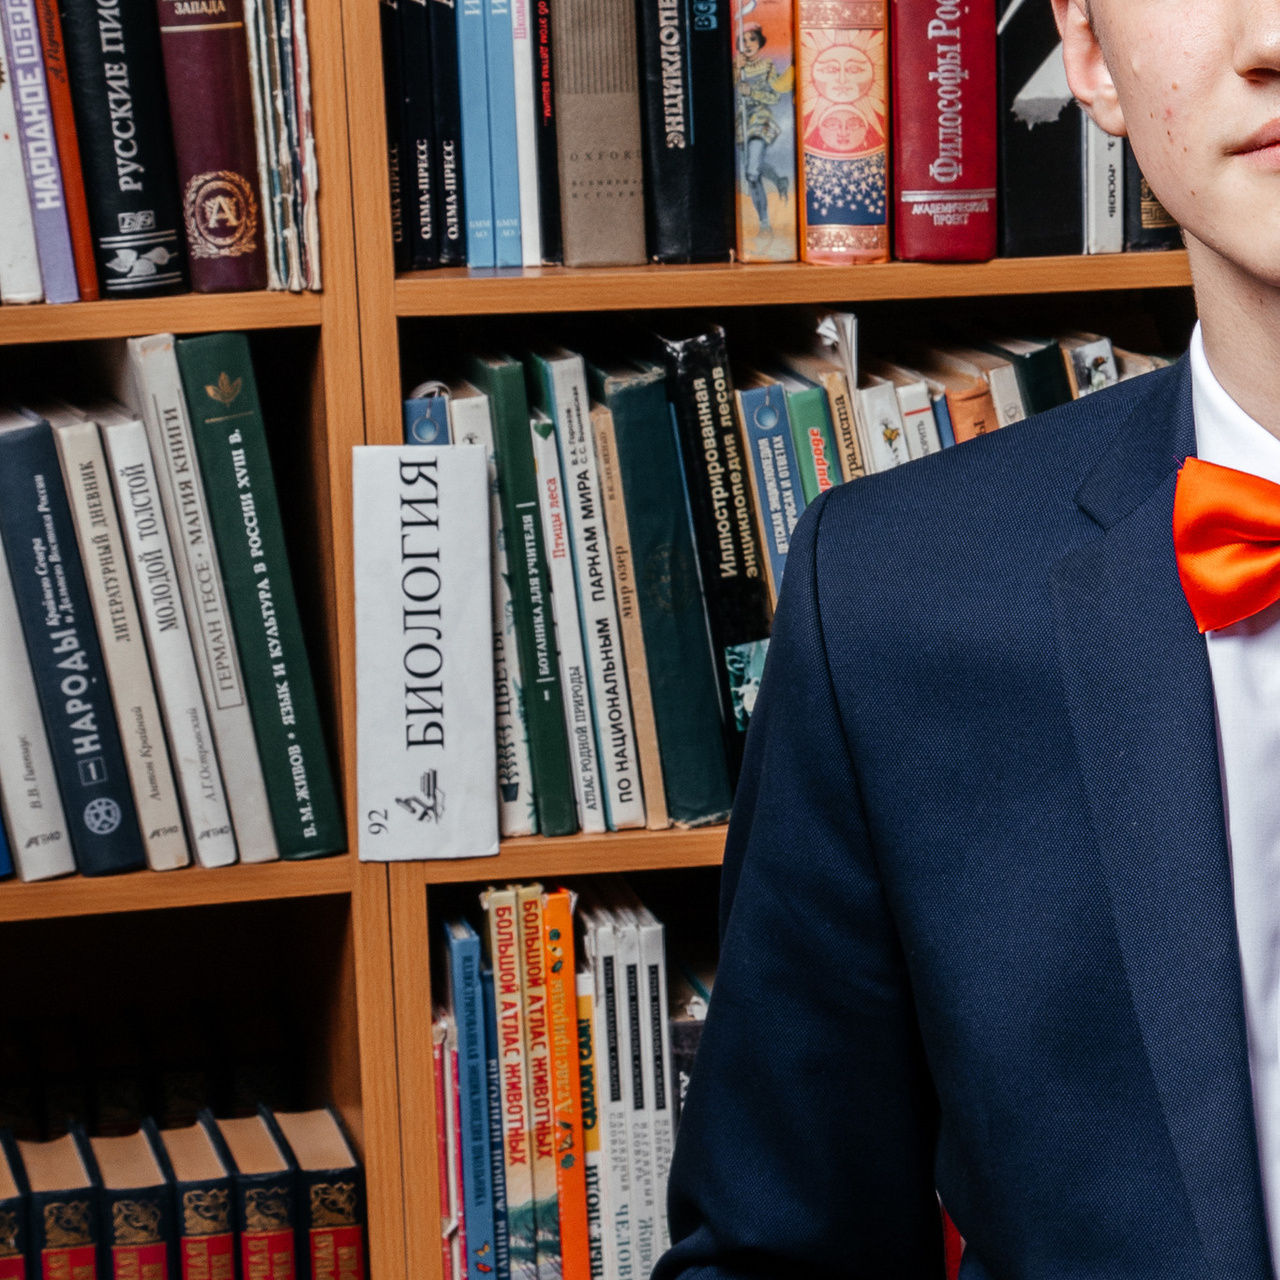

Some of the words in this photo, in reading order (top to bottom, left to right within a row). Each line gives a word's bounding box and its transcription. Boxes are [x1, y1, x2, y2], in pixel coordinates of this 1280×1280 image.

[17, 68, 60, 209] НАРОДНОЕ
[105, 63, 142, 191] РУССКИЕ
[929, 43, 967, 182] Философы
[710, 367, 732, 427] лесов
[162, 407, 192, 475] КНИГИ
[232, 449, 250, 488] XVIII
[79, 461, 109, 528] ДНЕВНИК
[121, 462, 158, 538] ТОЛСТОЙ
[576, 470, 598, 519] МИРА
[695, 377, 738, 578] Иллюстрированная
[725, 433, 758, 579] энциклопедия
[179, 480, 204, 546] МАГИЯ
[243, 493, 265, 557] РОССИИ
[522, 515, 538, 575] УЧИТЕЛЯ
[92, 533, 130, 643] ЛИТЕРАТУРНЫЙ
[142, 549, 179, 631] МОЛОДОЙ
[197, 562, 219, 614] ГЕССЕ
[255, 562, 267, 573] В
[529, 577, 541, 604] ДЛЯ
[256, 578, 284, 658] КУЛЬТУРА
[399, 457, 445, 750] БИОЛОГИЯ
[210, 619, 234, 691] ГЕРМАН
[273, 664, 287, 676] И
[532, 607, 550, 675] БОТАНИКА
[51, 629, 101, 753] НАРОДЫ
[275, 681, 296, 725] ЯЗЫК
[596, 618, 631, 772] НАЦИОНАЛЬНЫМ
[287, 745, 311, 800] ЖИВОВ
[617, 778, 633, 803] ПО
[368, 809, 388, 835] 92
[495, 906, 522, 992] БОЛЬШОЙ
[502, 999, 522, 1059] АТЛАС
[506, 1066, 526, 1165] ЖИВОТНЫХ
